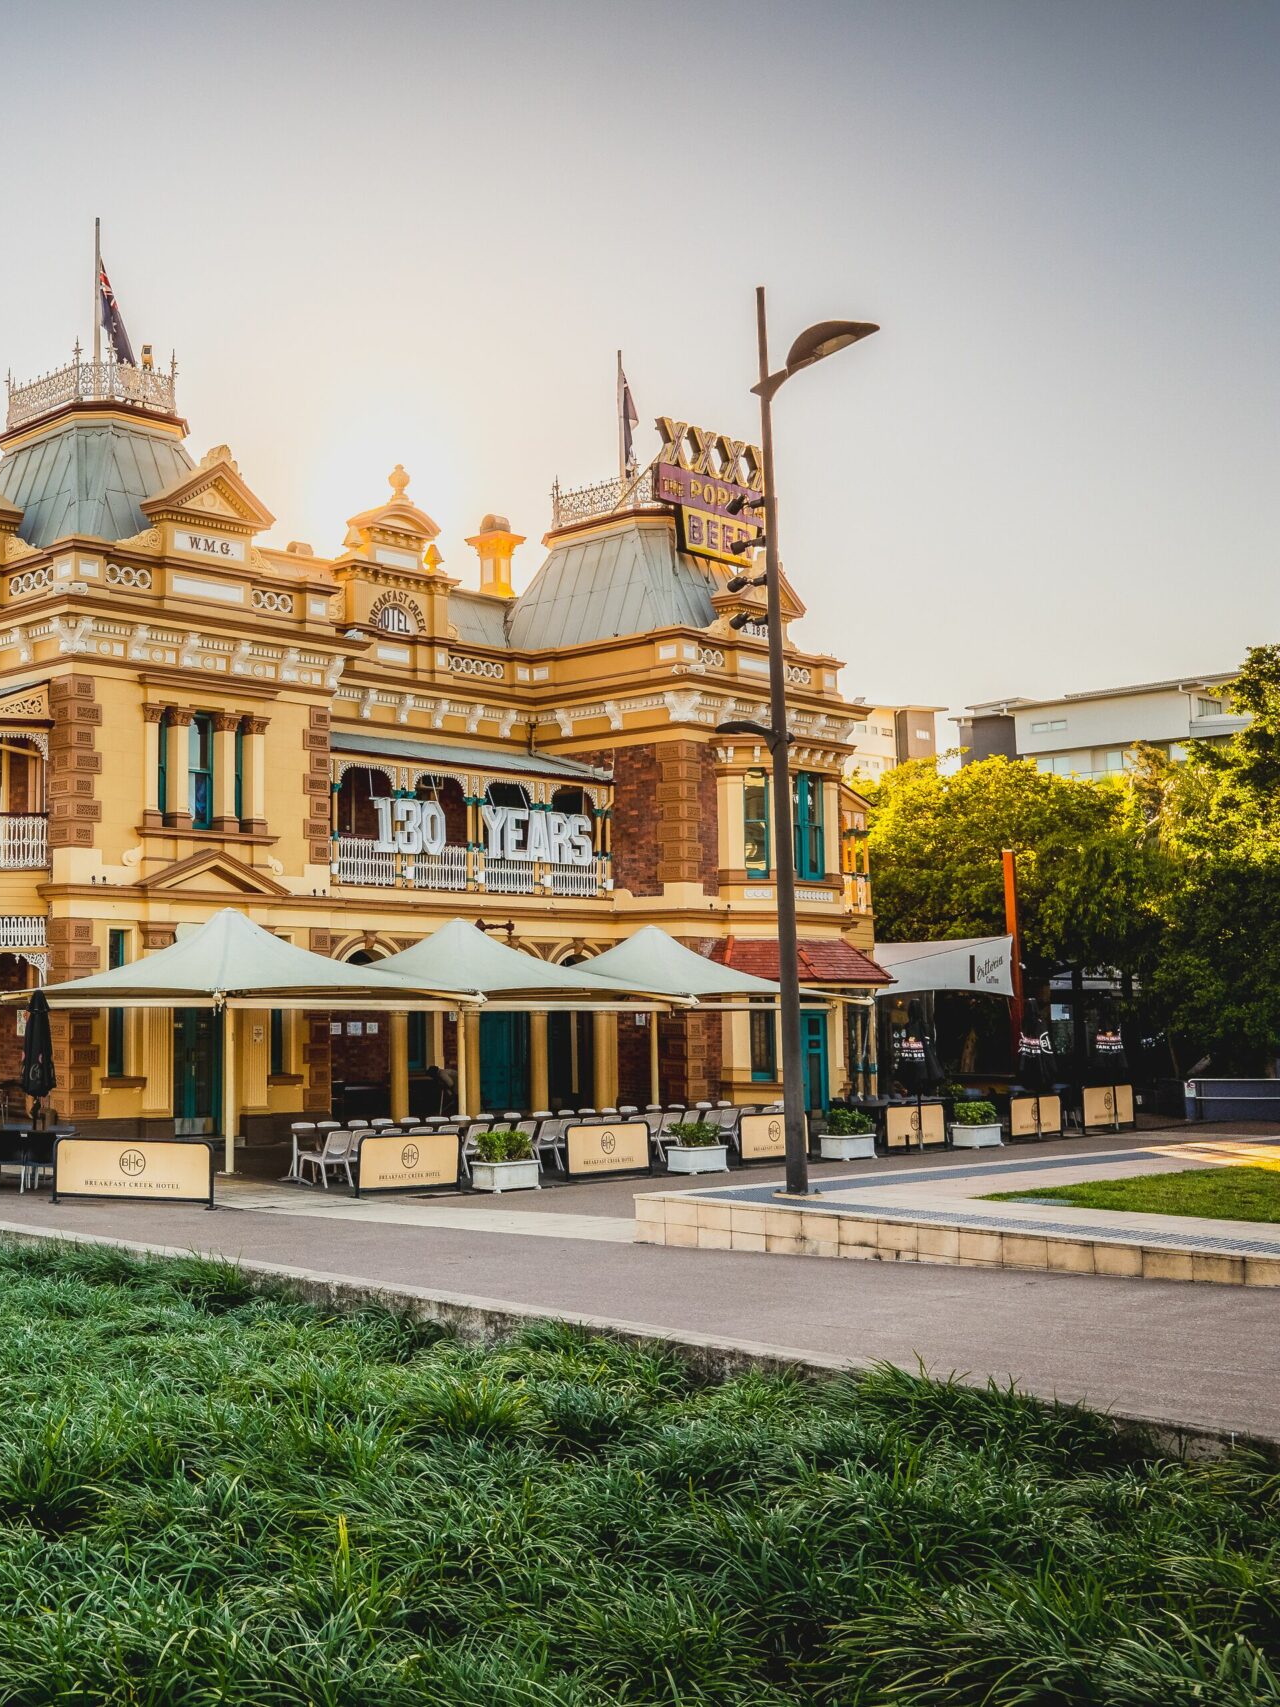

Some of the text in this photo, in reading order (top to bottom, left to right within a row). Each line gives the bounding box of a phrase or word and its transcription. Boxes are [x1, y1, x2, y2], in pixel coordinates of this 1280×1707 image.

[655, 416, 764, 492] XXXX
[663, 477, 686, 498] THE
[688, 514, 752, 559] BEER
[368, 590, 427, 633] BREAKFAST CREEK
[377, 606, 410, 633] HOTEL
[372, 797, 593, 866] 130 YEARS
[84, 1180, 127, 1188] BREAKFAST
